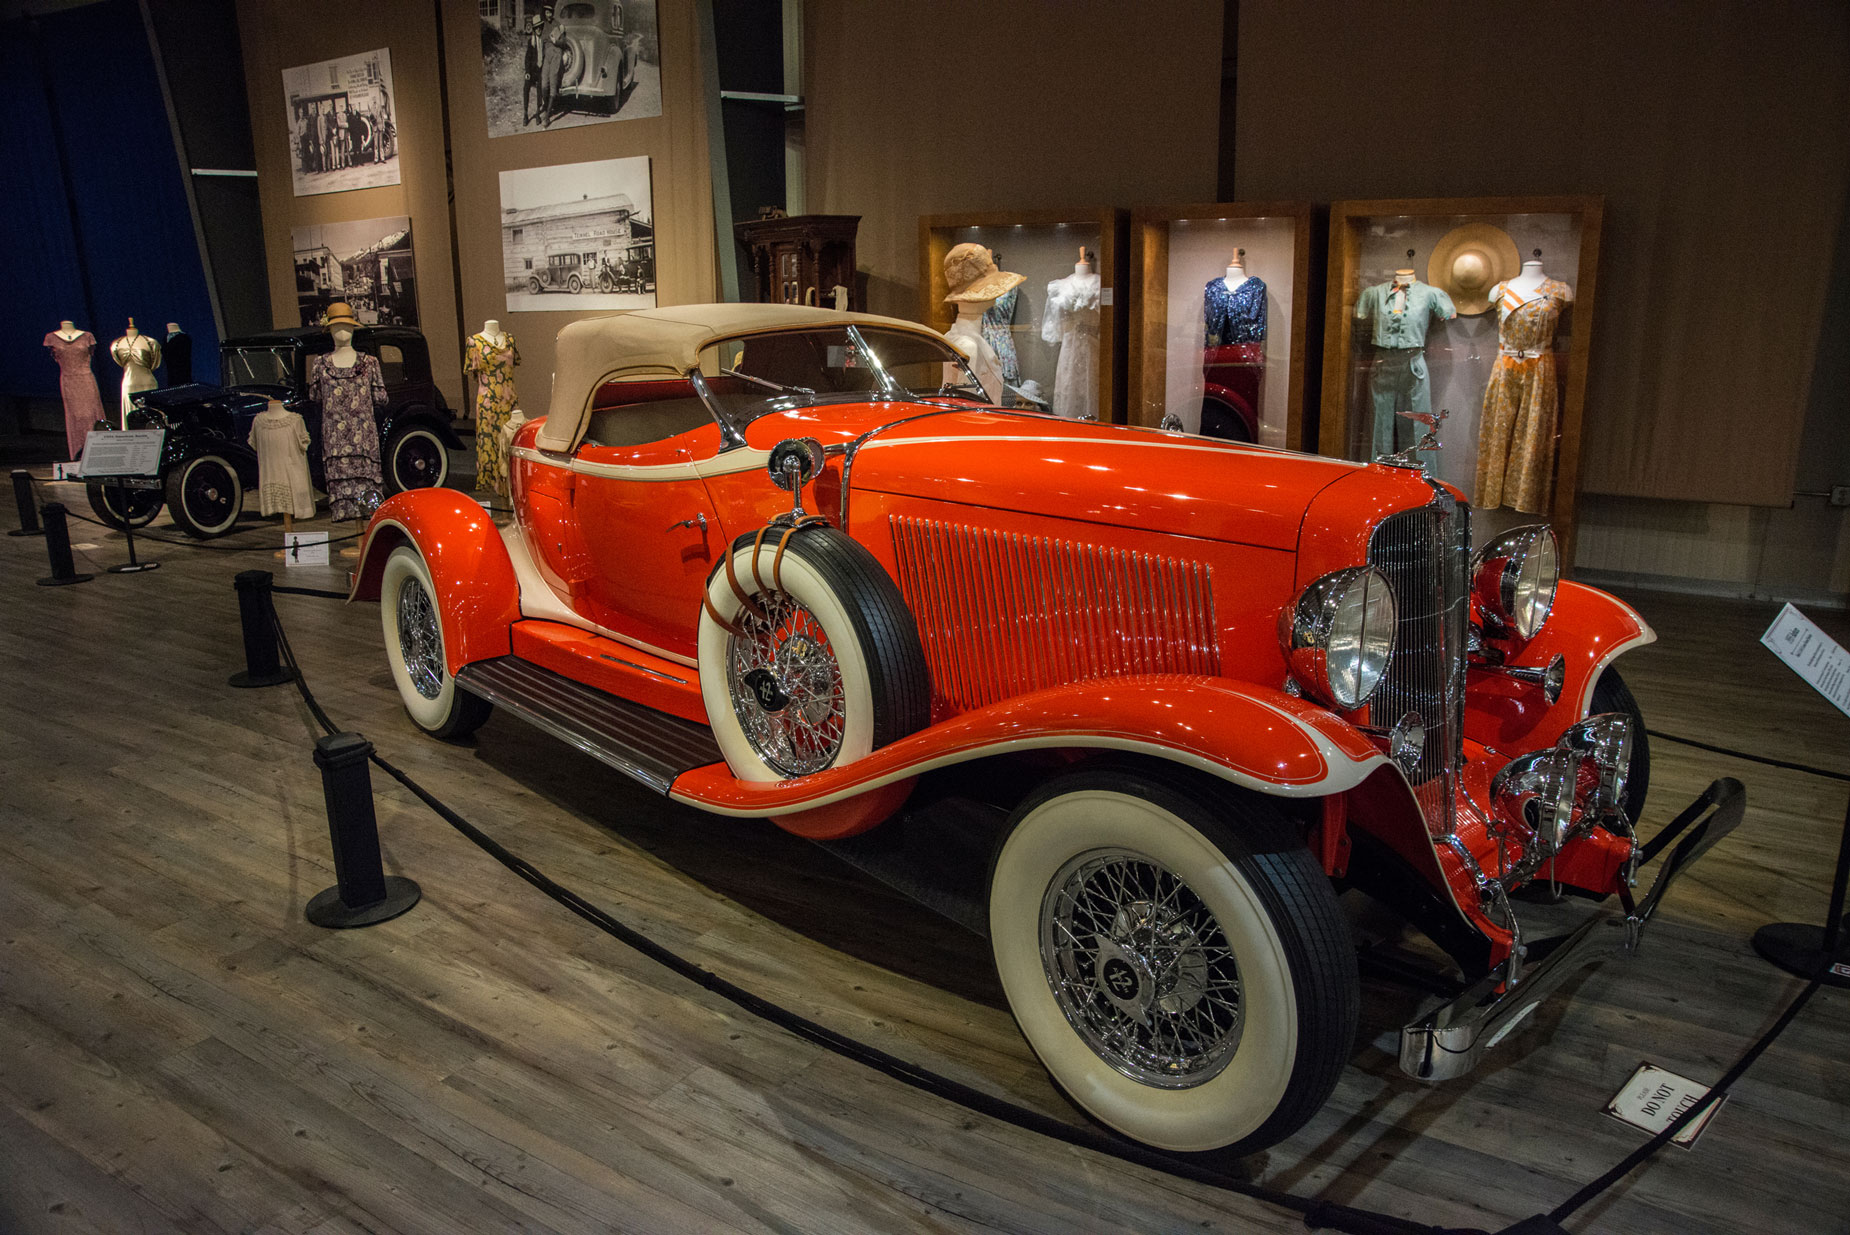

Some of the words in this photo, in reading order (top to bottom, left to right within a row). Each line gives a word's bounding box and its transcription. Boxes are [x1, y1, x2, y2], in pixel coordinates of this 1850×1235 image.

[1641, 1101, 1661, 1117] DO
[1652, 1083, 1675, 1104] NOT
[1666, 1094, 1700, 1123] TOUCH
